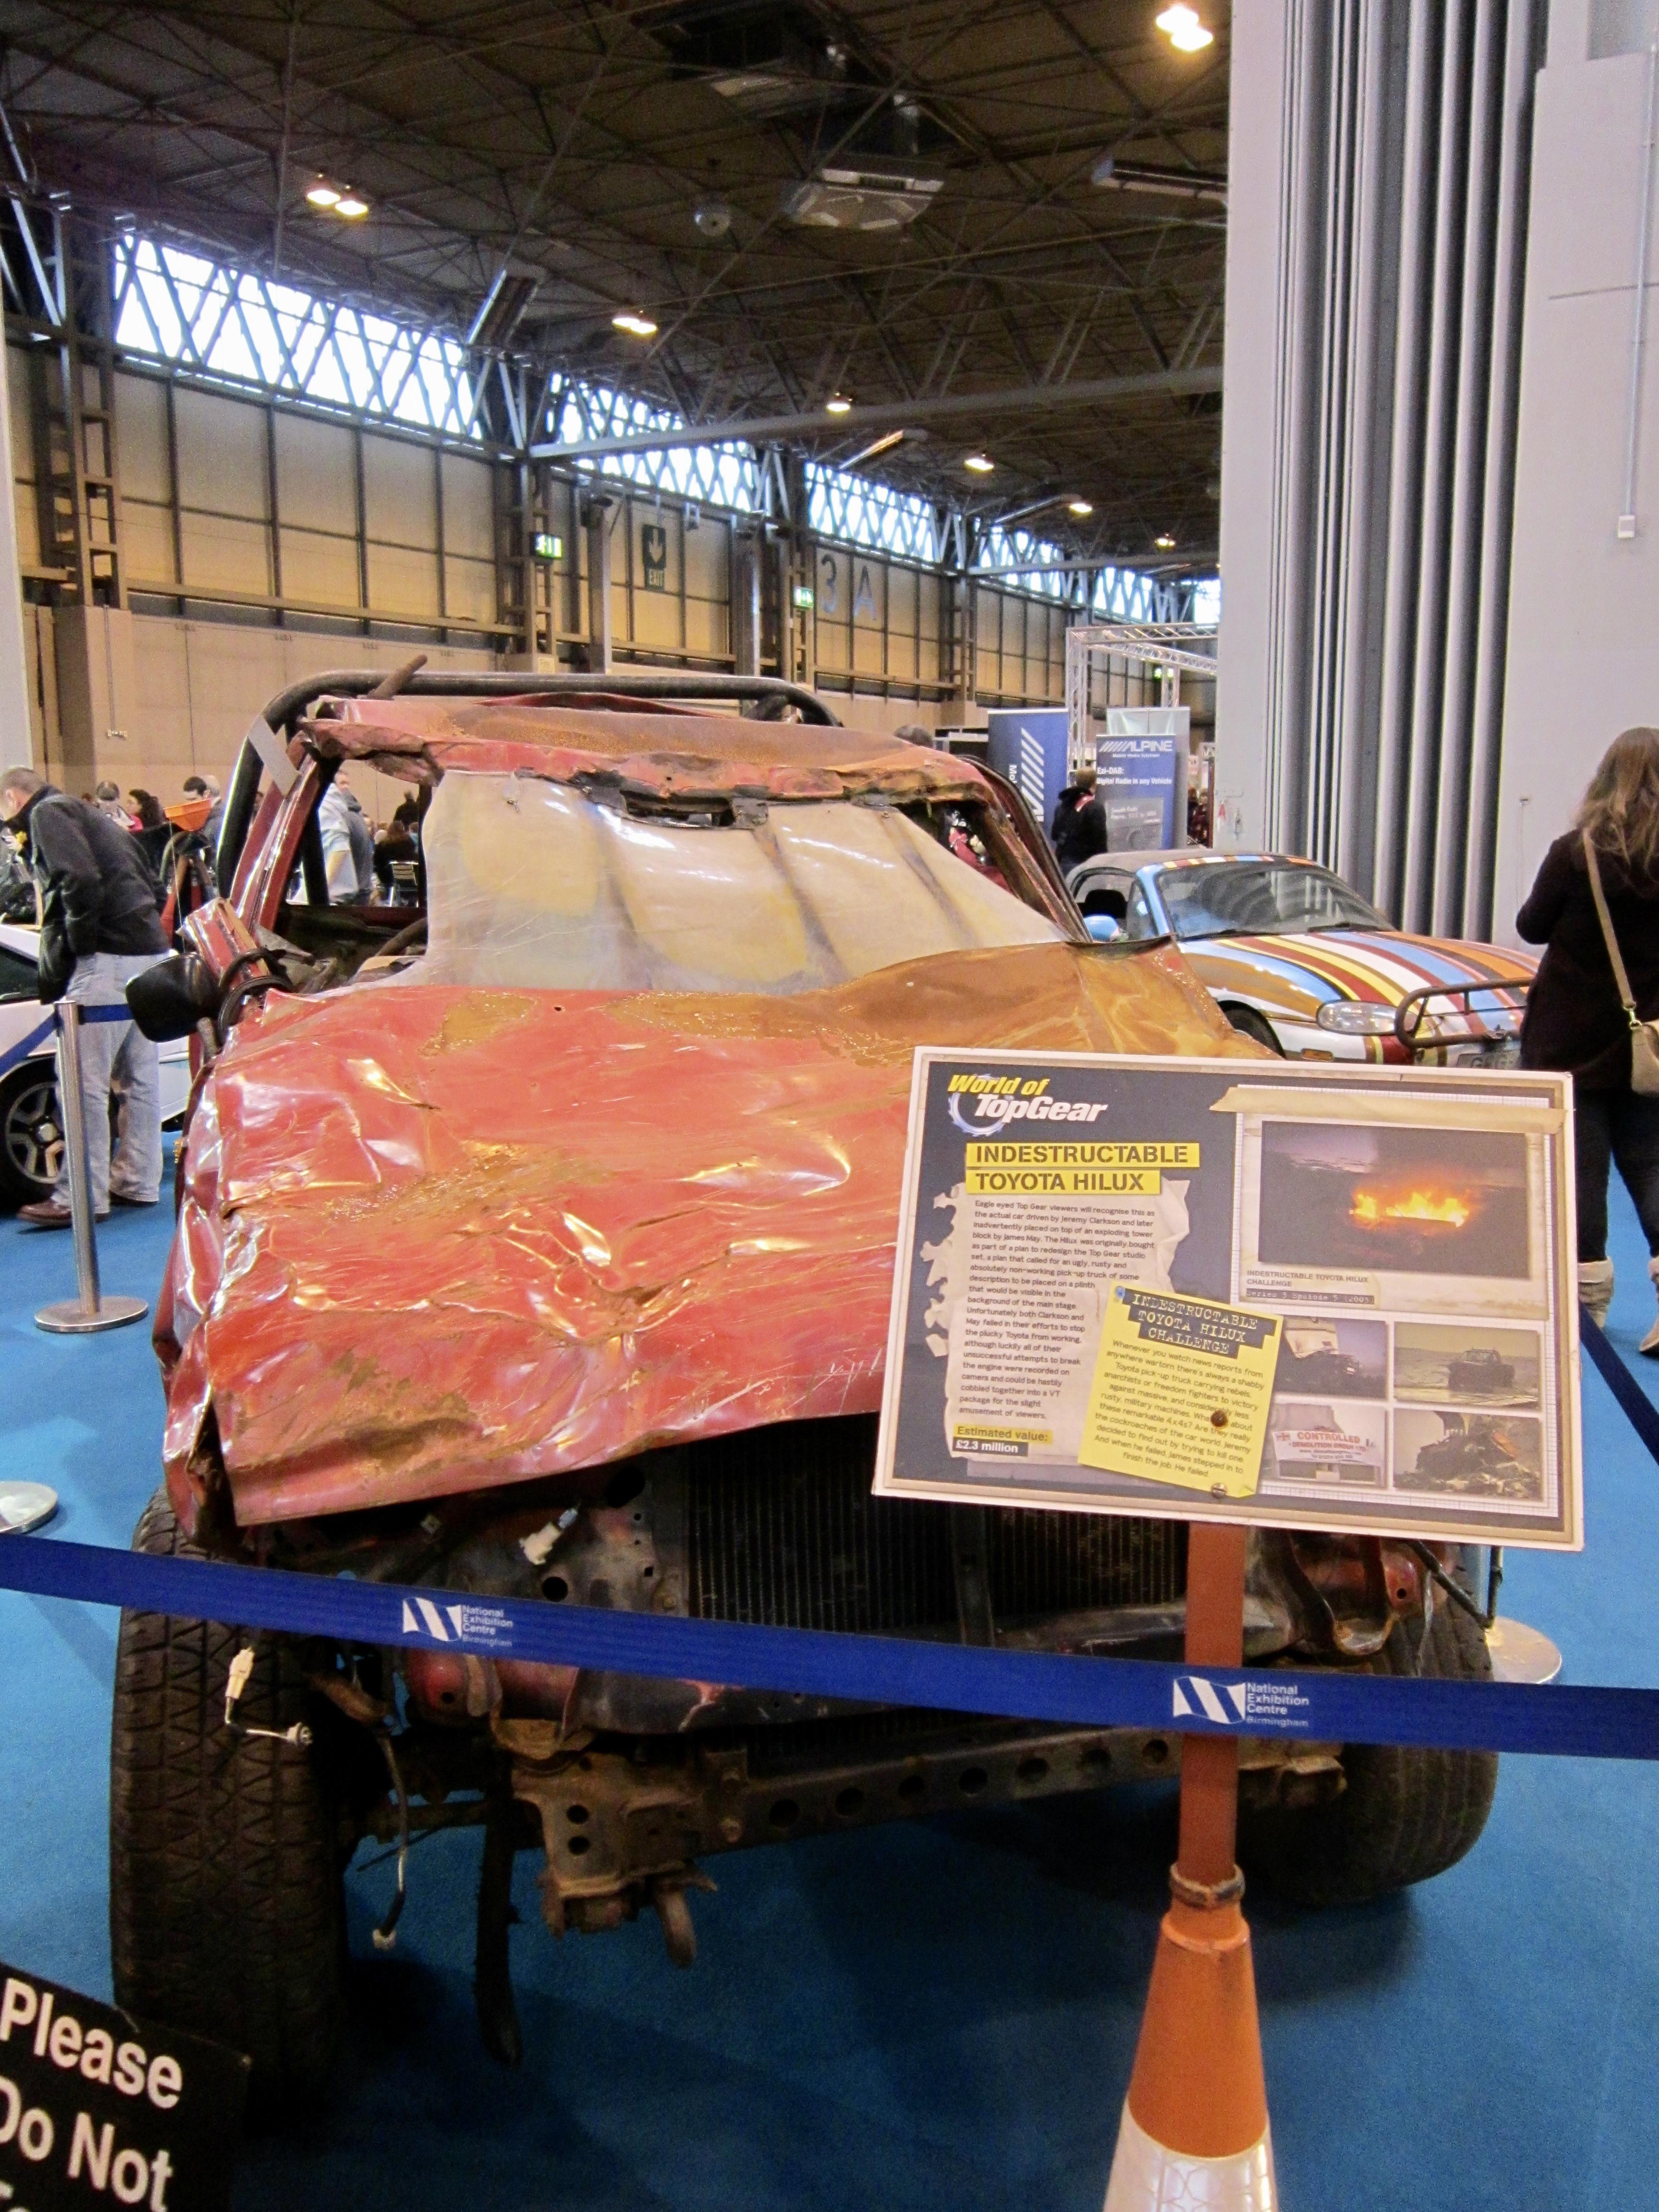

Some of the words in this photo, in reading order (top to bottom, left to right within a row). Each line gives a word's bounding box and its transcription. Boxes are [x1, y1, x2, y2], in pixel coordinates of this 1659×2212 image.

[821, 554, 837, 613] 3
[854, 565, 877, 620] A
[1099, 740, 1173, 752] ALPINE
[948, 1075, 1022, 1094] World
[1021, 1079, 1050, 1095] of
[974, 1094, 1108, 1123] TopGear
[976, 1145, 1188, 1163] INDESTRUCTABLE
[976, 1173, 1066, 1190] TOYOTA
[1073, 1173, 1144, 1191] HILUX
[974, 1200, 995, 1209] Eagle
[996, 1201, 1014, 1210] eyed
[1016, 1202, 1028, 1211] Top
[1093, 1206, 1129, 1216] recognise
[1050, 1214, 1059, 1223] by
[1061, 1215, 1087, 1225] Jeremy
[1089, 1216, 1120, 1225] Clarkson
[973, 1221, 1022, 1232] inadvertently
[1024, 1224, 1048, 1233] placed
[1060, 1226, 1073, 1235] top
[1094, 1227, 1130, 1238] exploding
[993, 1233, 1002, 1241] by
[1003, 1233, 1025, 1242] James
[1094, 1238, 1127, 1248] originally
[1128, 1240, 1155, 1250] bought
[981, 1243, 997, 1251] part
[1014, 1245, 1029, 1253] plan
[1040, 1246, 1072, 1256] redesign
[1088, 1249, 1102, 1258] Top
[970, 1263, 1007, 1274] absolutely
[1009, 1266, 1055, 1277] non-working
[1056, 1269, 1085, 1278] pick-up
[1248, 1271, 1313, 1279] INDESTRUCTABLE
[969, 1274, 1010, 1285] description
[1032, 1278, 1056, 1287] placed
[1074, 1281, 1095, 1290] plinth
[967, 1296, 1010, 1307] background
[1055, 1301, 1077, 1311] stage
[966, 1306, 1017, 1318] Unfortunately
[1037, 1311, 1070, 1320] Clarkson
[1132, 1294, 1258, 1329] INDESTRUCTABLE
[965, 1317, 980, 1326] May
[1031, 1322, 1058, 1330] efforts
[1069, 1324, 1085, 1334] stop
[1138, 1310, 1191, 1332] TOYOTA
[1200, 1323, 1247, 1343] HILUX
[963, 1339, 997, 1349] although
[998, 1342, 1022, 1351] luckily
[1148, 1327, 1229, 1354] CHALLENGE
[963, 1350, 1012, 1360] unsuccessful
[1013, 1354, 1048, 1364] attempts
[1112, 1340, 1151, 1354] Whenever
[1152, 1350, 1166, 1359] you
[1167, 1352, 1191, 1362] watch
[1192, 1358, 1212, 1367] news
[1213, 1361, 1243, 1375] reports
[1244, 1368, 1263, 1378] from
[1103, 1370, 1142, 1385] anarchists
[1153, 1381, 1187, 1395] freedom
[1187, 1389, 1219, 1404] fighters
[1230, 1398, 1259, 1413] victory
[958, 1426, 1011, 1438] Estimated
[1015, 1431, 1048, 1441] value:
[1298, 1432, 1360, 1443] CONTROLLED
[956, 1440, 978, 1450] £2.3
[982, 1441, 1018, 1453] million
[462, 1605, 504, 1617] National
[463, 1613, 513, 1627] Exhibition
[463, 1623, 495, 1635] Centre
[1248, 1683, 1298, 1695] National
[1248, 1693, 1310, 1706] Exhibition
[1248, 1704, 1287, 1715] Centre
[1248, 1716, 1309, 1728] Birmingham
[0, 1978, 182, 2109] Please
[0, 2075, 54, 2161] Do
[68, 2112, 173, 2212] Not
